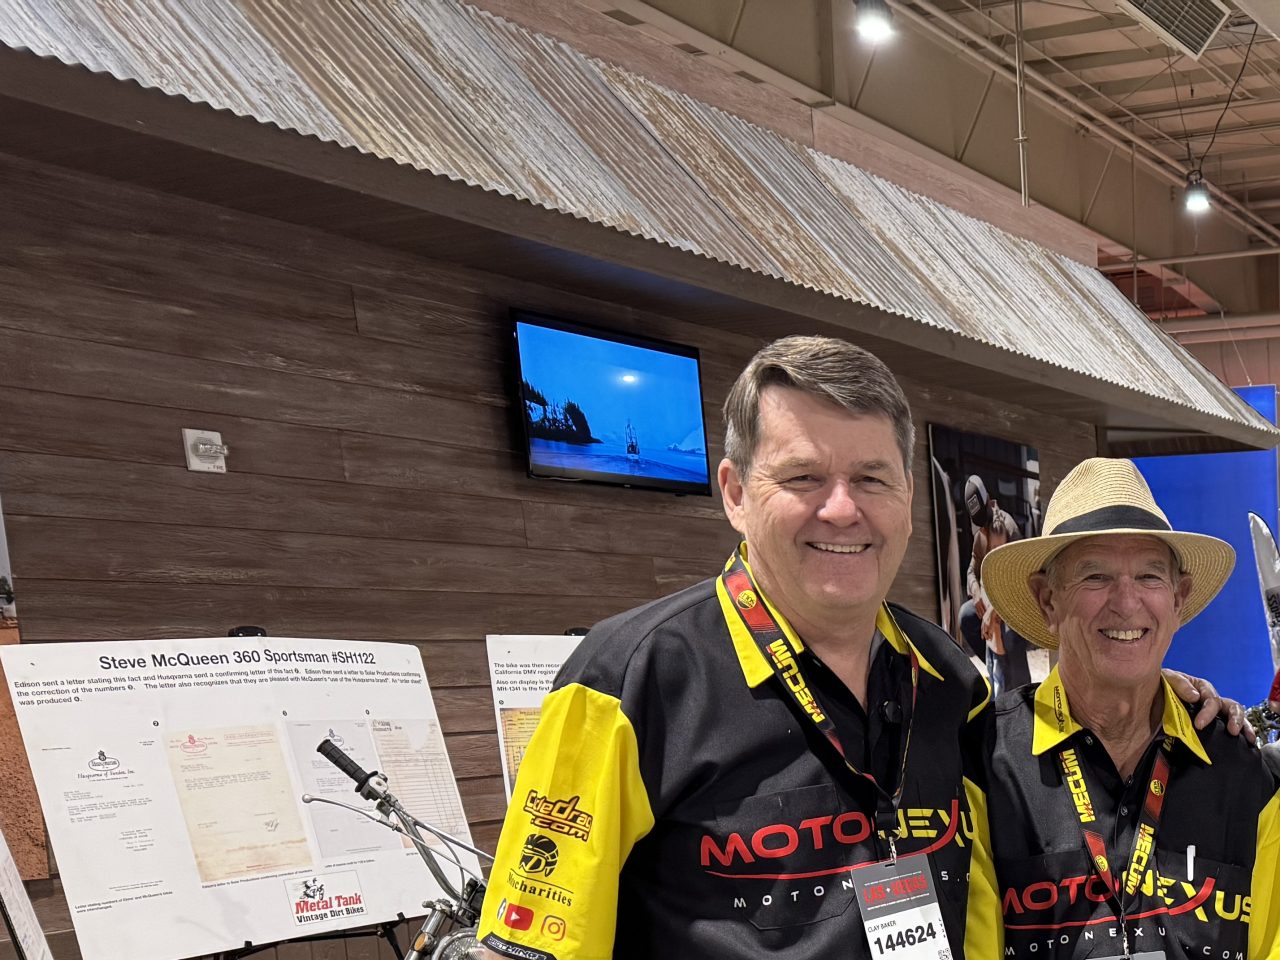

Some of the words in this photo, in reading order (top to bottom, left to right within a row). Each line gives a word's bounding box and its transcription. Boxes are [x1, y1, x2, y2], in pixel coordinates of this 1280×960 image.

[99, 654, 147, 670] Steve
[151, 652, 229, 668] McQueen
[233, 650, 260, 664] 360
[264, 649, 329, 664] Sportsman
[332, 651, 376, 664] #SH1122
[157, 673, 193, 681] Husqvarna
[767, 638, 826, 724] MECUM
[31, 688, 70, 696] correction
[36, 697, 72, 705] produced
[1061, 748, 1096, 823] MECUM
[1126, 822, 1156, 896] MECUM
[295, 896, 333, 915] Metal
[335, 893, 362, 908] Tank
[296, 912, 329, 923] Vintage
[329, 909, 345, 918] Dirt
[345, 906, 364, 915] Bikes
[867, 922, 881, 933] CLAY
[881, 920, 897, 930] BAKER
[874, 922, 937, 955] 144624
